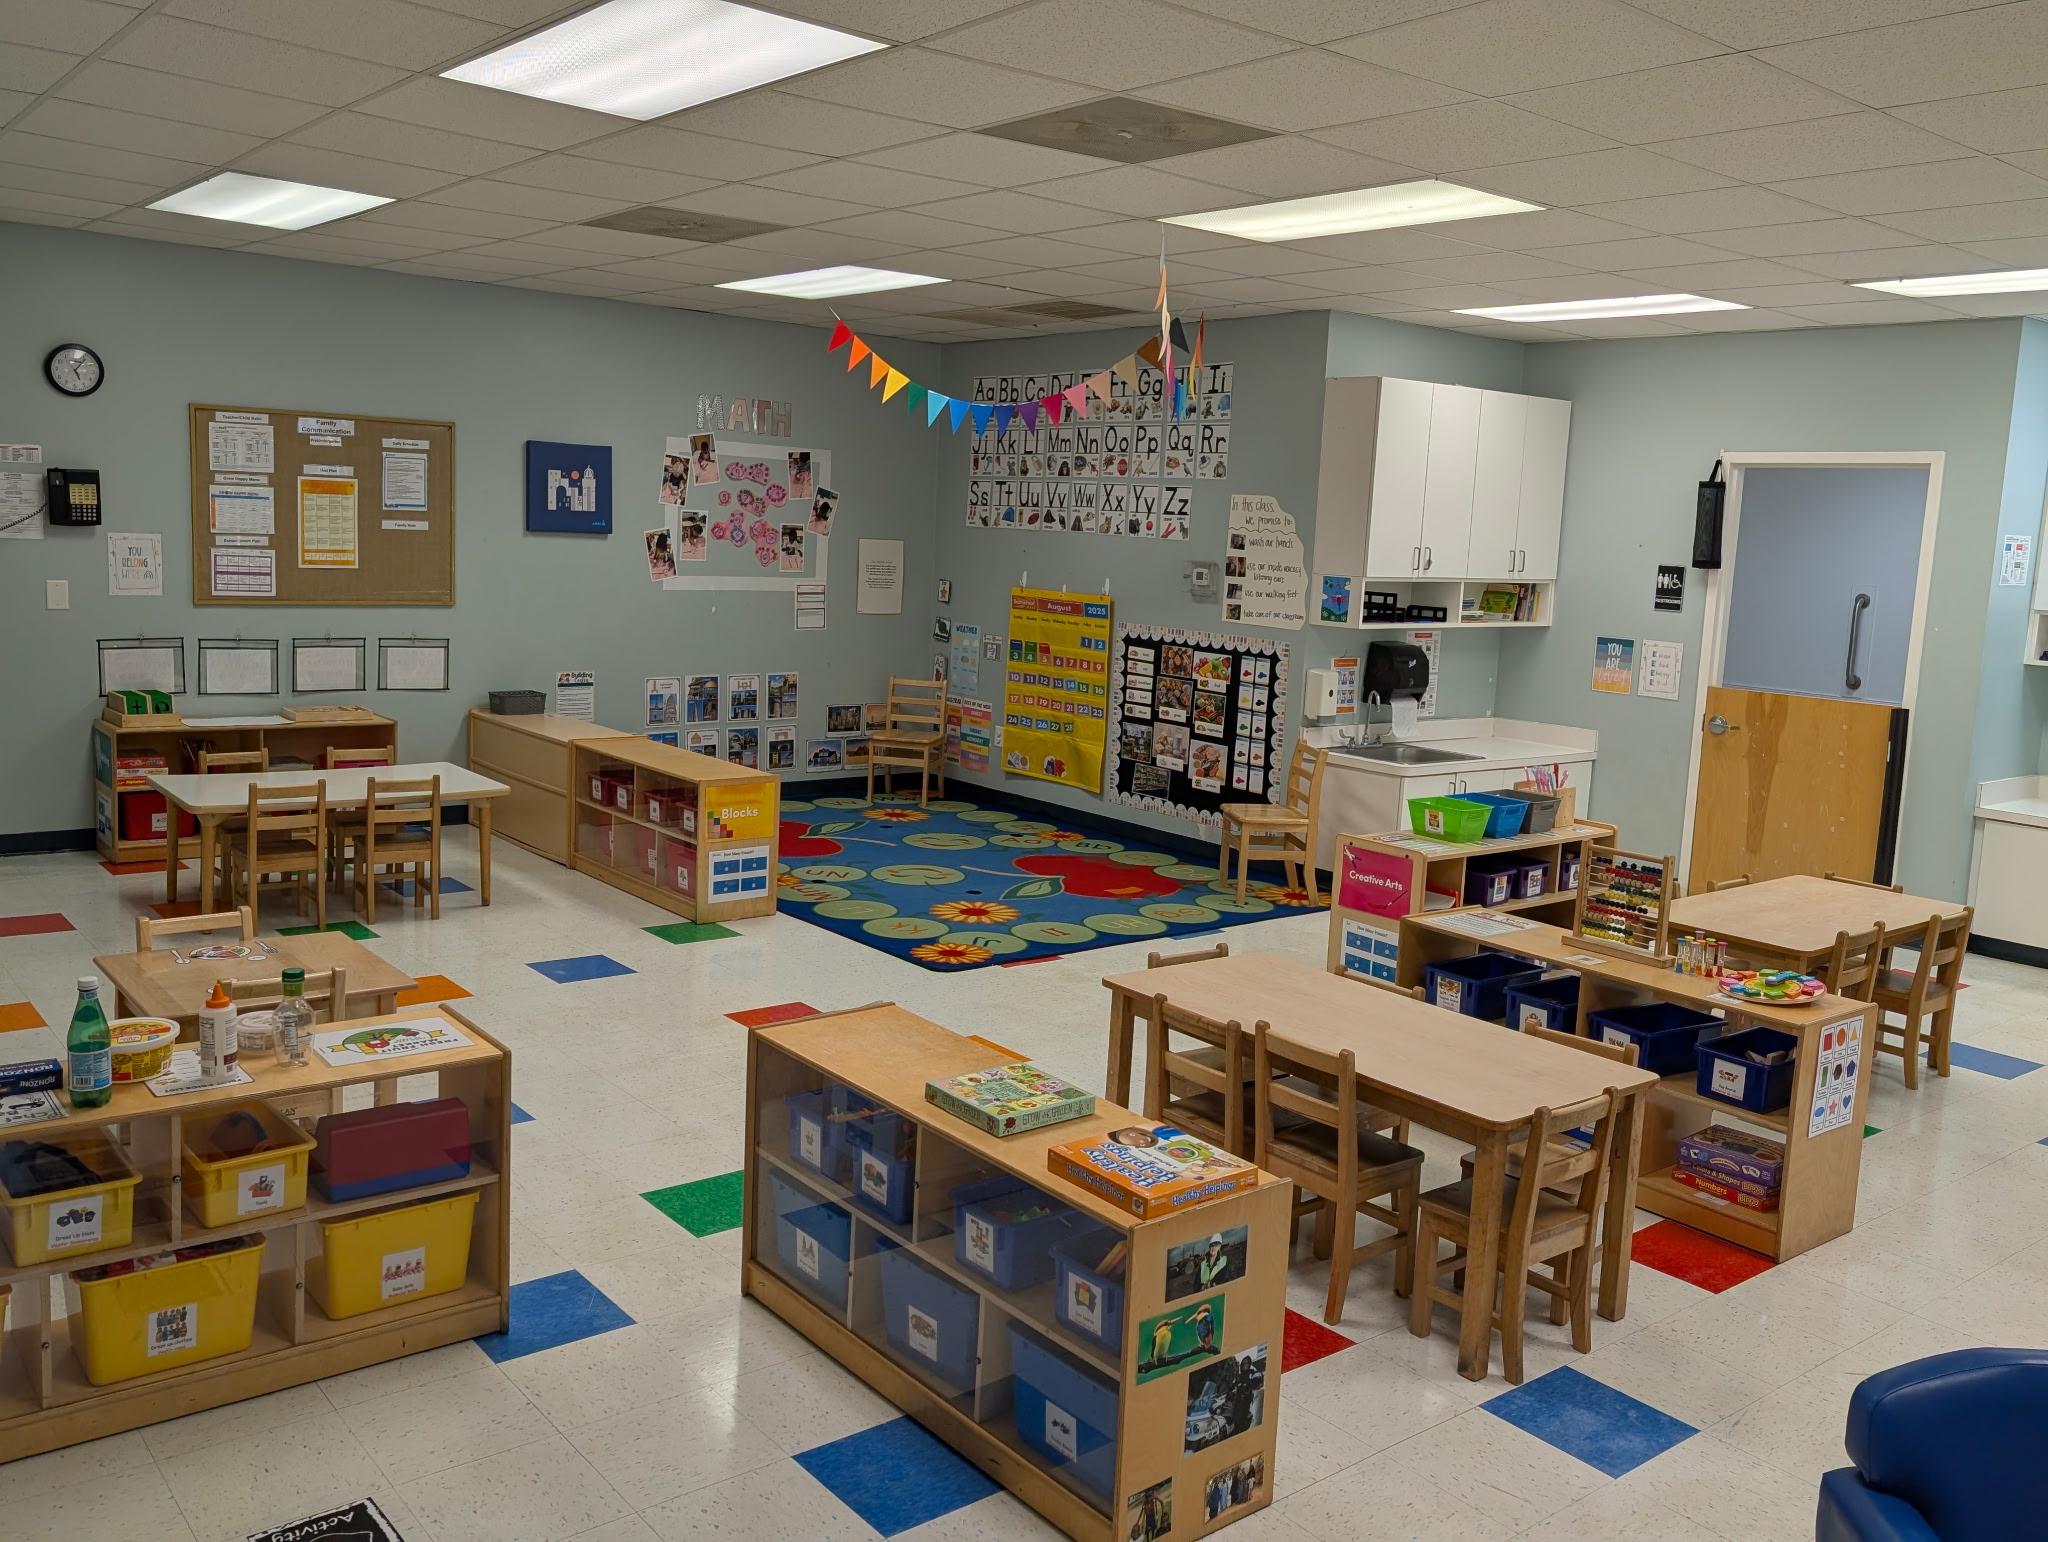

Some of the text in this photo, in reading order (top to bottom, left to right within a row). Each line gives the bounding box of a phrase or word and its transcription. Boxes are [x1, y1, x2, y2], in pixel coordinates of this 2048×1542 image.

[974, 378, 995, 401] Aa
[999, 378, 1019, 402] Bb
[1024, 377, 1046, 401] Cc
[1138, 369, 1163, 401] Gg
[1208, 365, 1226, 393] Ii
[697, 393, 792, 437] MATH
[302, 426, 351, 434] Communication
[1048, 428, 1071, 452] Mm
[1076, 428, 1099, 454] Nn
[1105, 426, 1129, 452] Oo
[1168, 425, 1194, 457] Qq
[1201, 425, 1226, 453] Rr
[997, 430, 1017, 454] Kk
[1135, 425, 1159, 460] Pp
[969, 481, 989, 506] Ss
[995, 481, 1014, 506] Tt
[1019, 482, 1040, 507] Uu
[1046, 482, 1068, 508] Vv
[1073, 484, 1095, 507] Ww
[1102, 484, 1124, 511] Xx
[1132, 485, 1155, 520] Yy
[1163, 487, 1190, 515] Zz
[1242, 498, 1253, 512] this
[1258, 516, 1281, 532] promise
[128, 546, 142, 556] YOU
[1249, 536, 1293, 548] wash our hands
[122, 558, 148, 568] BELONG
[1253, 573, 1273, 585] listening
[1255, 590, 1263, 598] our
[1265, 590, 1286, 601] walking
[1047, 603, 1072, 612] August
[1087, 607, 1106, 615] 2025
[1243, 609, 1254, 618] take
[1265, 610, 1272, 618] of
[956, 625, 977, 634] WEATHER
[1607, 643, 1622, 656] YOU
[1606, 658, 1620, 670] ARE
[1040, 676, 1048, 684] 12
[1039, 698, 1047, 706] 19
[1022, 718, 1031, 726] 25
[1051, 723, 1059, 731] 27
[722, 806, 758, 819] Blocks
[1349, 870, 1403, 891] Creative Arts
[381, 1038, 459, 1053] FRESH FRUIT
[391, 1038, 438, 1048] MARKET
[0, 1064, 53, 1076] RONZO
[20, 1075, 56, 1087] RONZONI
[964, 1105, 981, 1121] GARDEN
[1022, 1112, 1040, 1125] GROW
[1051, 1104, 1073, 1117] GARDEN
[1080, 1148, 1158, 1188] Healthy
[1099, 1142, 1182, 1183] Helpings
[1692, 1162, 1712, 1175] Colors
[1718, 1172, 1740, 1186] Shapes
[1066, 1163, 1125, 1201] Healthy Helpings
[1171, 1180, 1236, 1207] Healthy Helpings
[1696, 1178, 1727, 1195] Numbers
[271, 1511, 354, 1542] Activity
